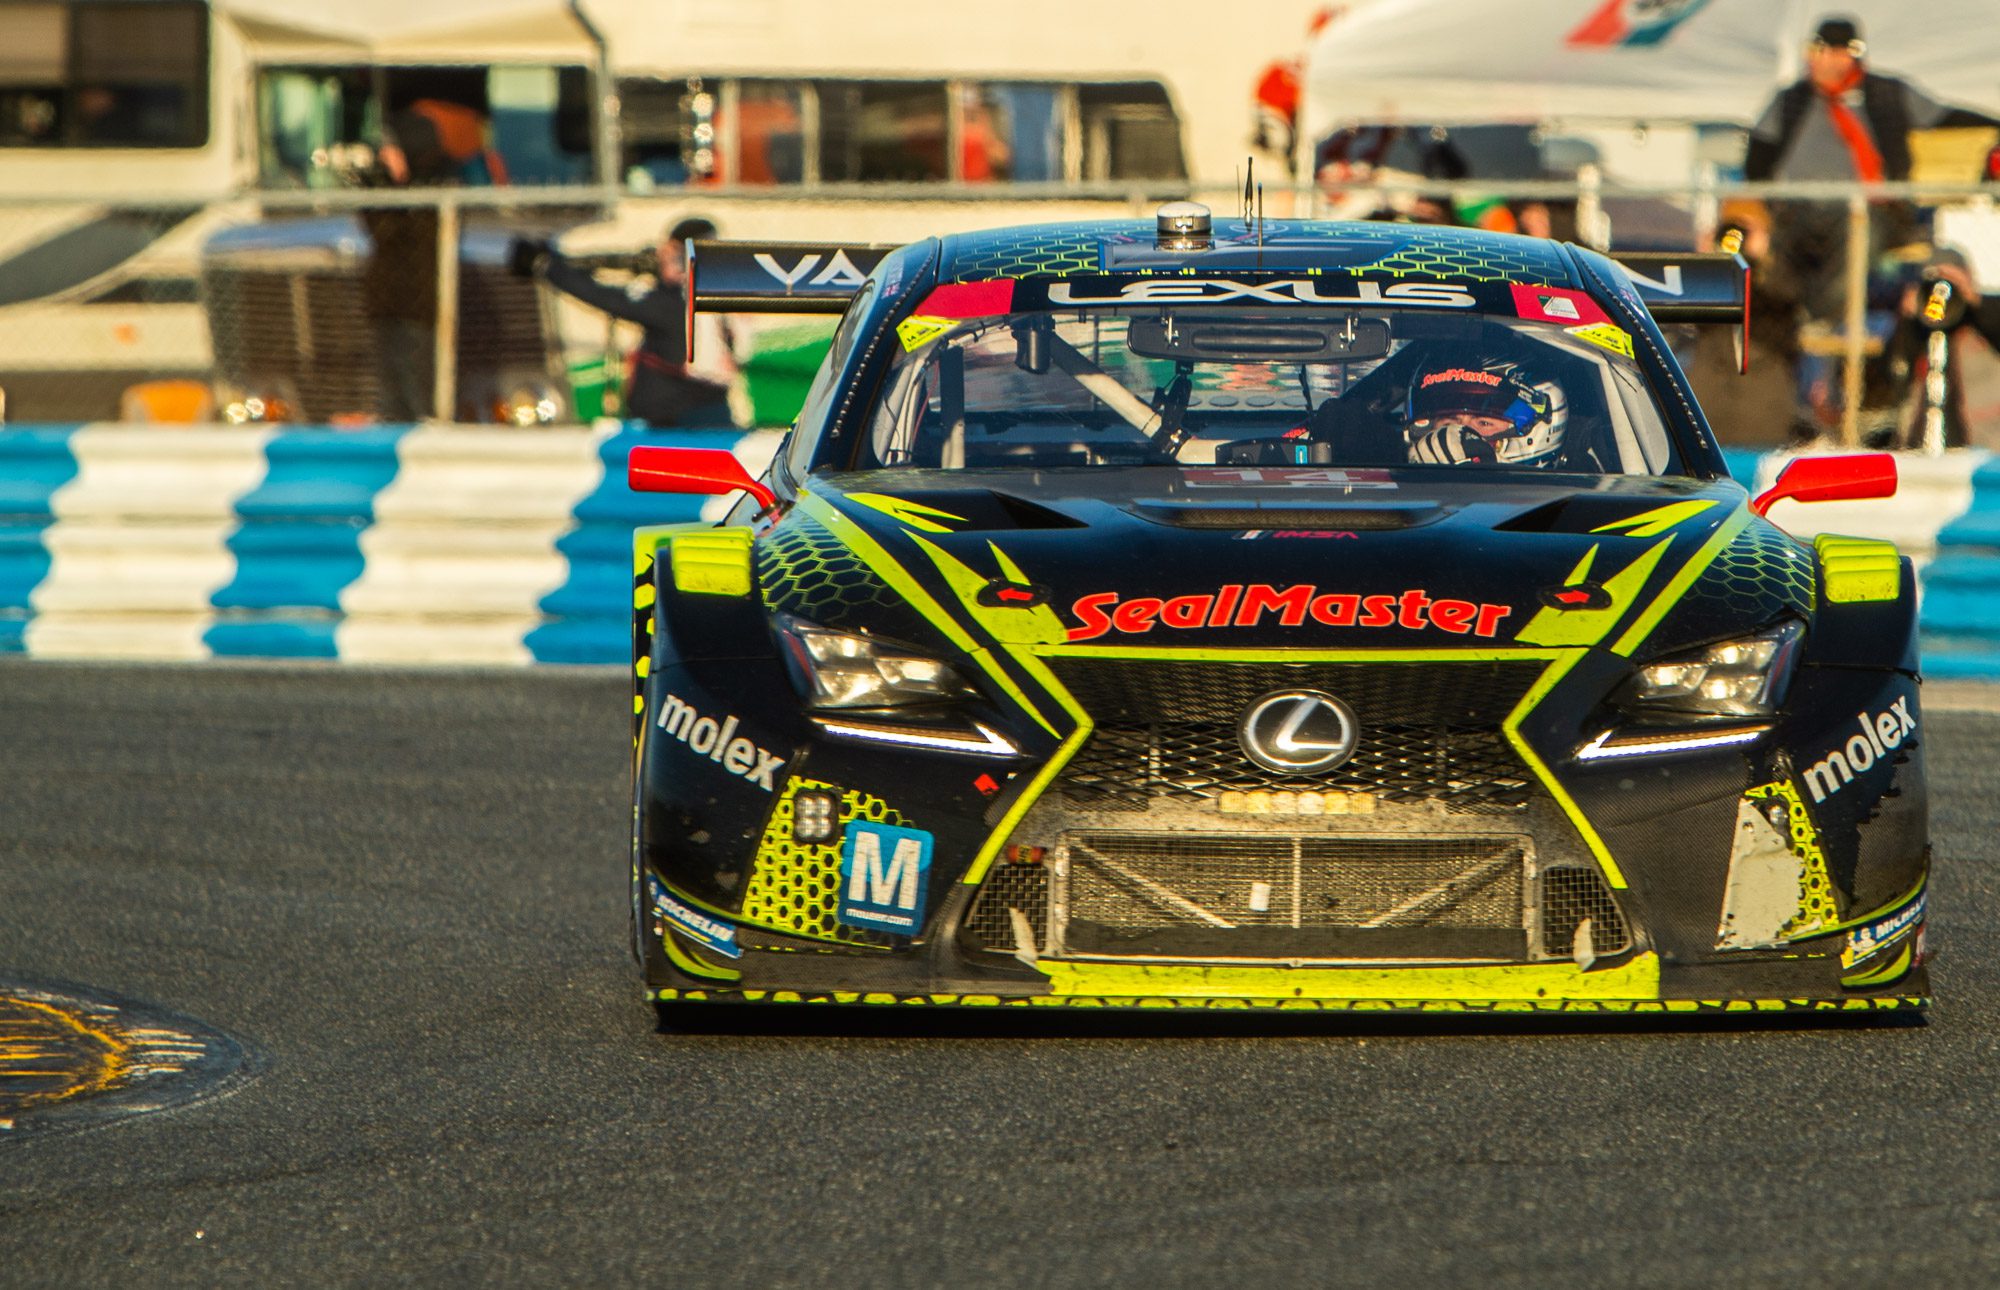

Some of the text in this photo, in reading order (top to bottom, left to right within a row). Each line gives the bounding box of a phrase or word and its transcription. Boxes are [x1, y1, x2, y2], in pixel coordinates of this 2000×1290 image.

[1048, 279, 1476, 307] LEXUS
[1420, 368, 1503, 390] SealMaster
[1066, 584, 1511, 641] SealMaster
[657, 694, 786, 792] molex
[1802, 695, 1917, 803] molex
[848, 831, 921, 910] M
